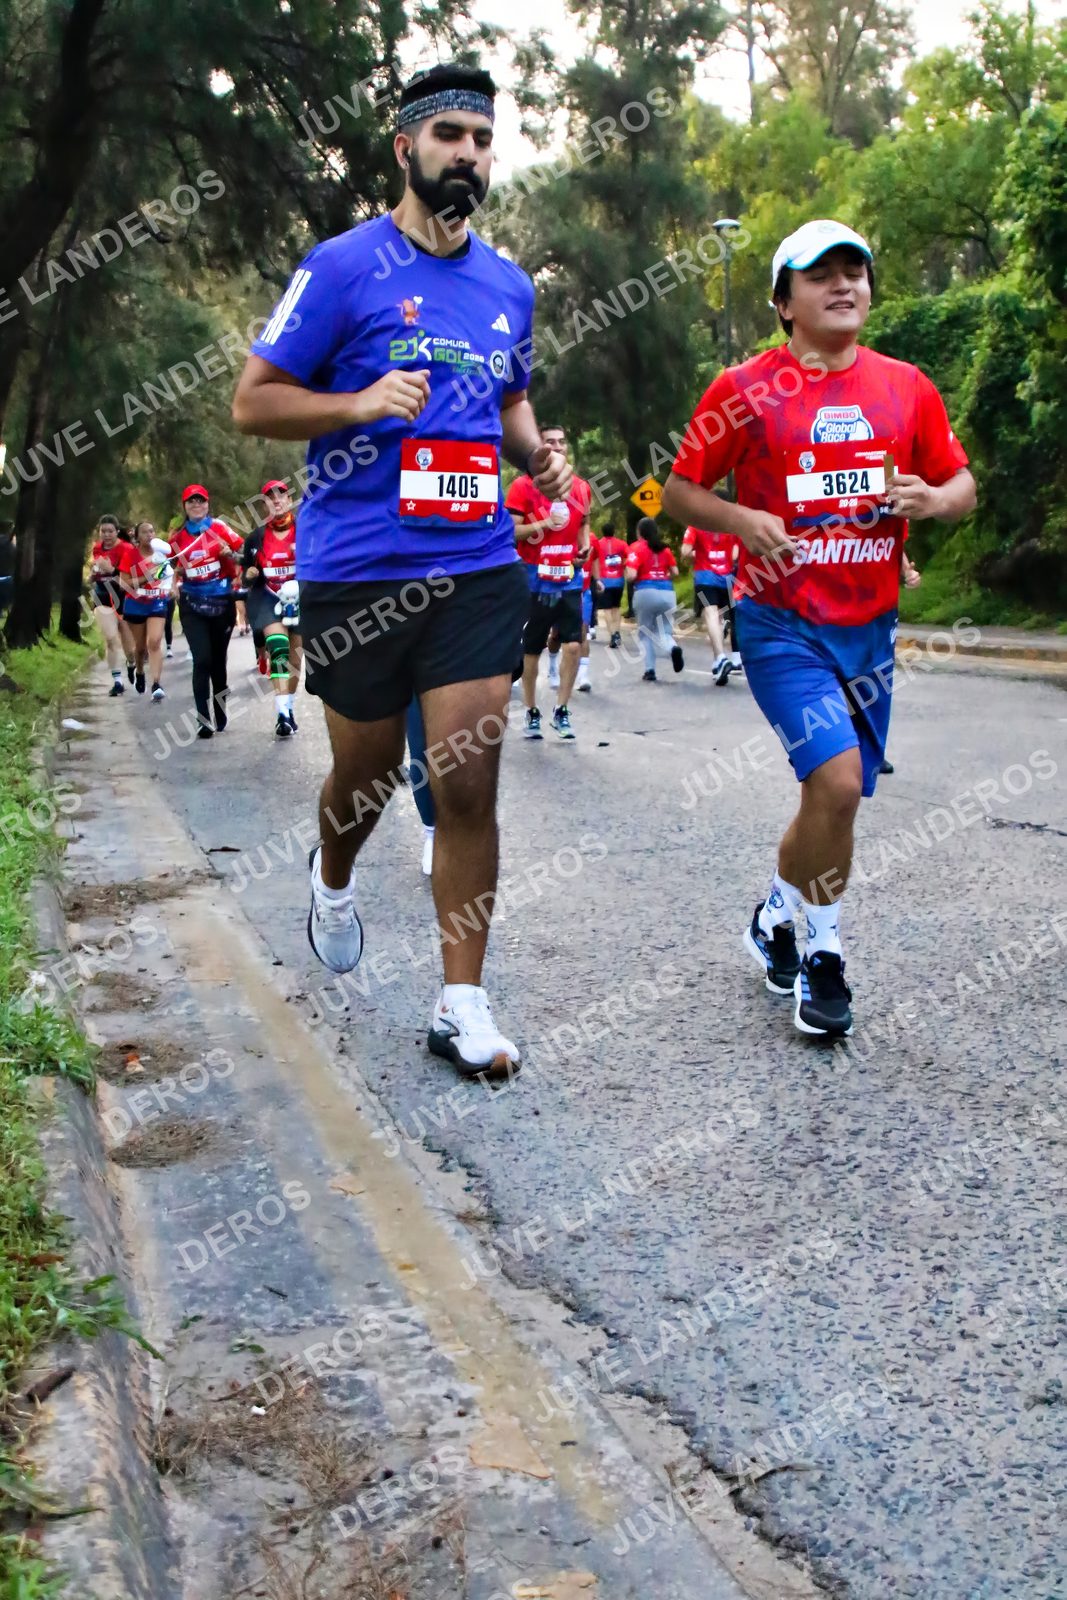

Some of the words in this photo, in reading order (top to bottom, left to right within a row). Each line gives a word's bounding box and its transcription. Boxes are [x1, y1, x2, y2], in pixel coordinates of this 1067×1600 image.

[432, 337, 470, 350] COMUDE
[823, 411, 856, 420] BIMBO
[825, 422, 857, 434] Global
[820, 432, 846, 442] Race
[437, 474, 479, 499] 1405
[821, 470, 871, 496] 3624
[793, 537, 896, 565] SANTIAGO
